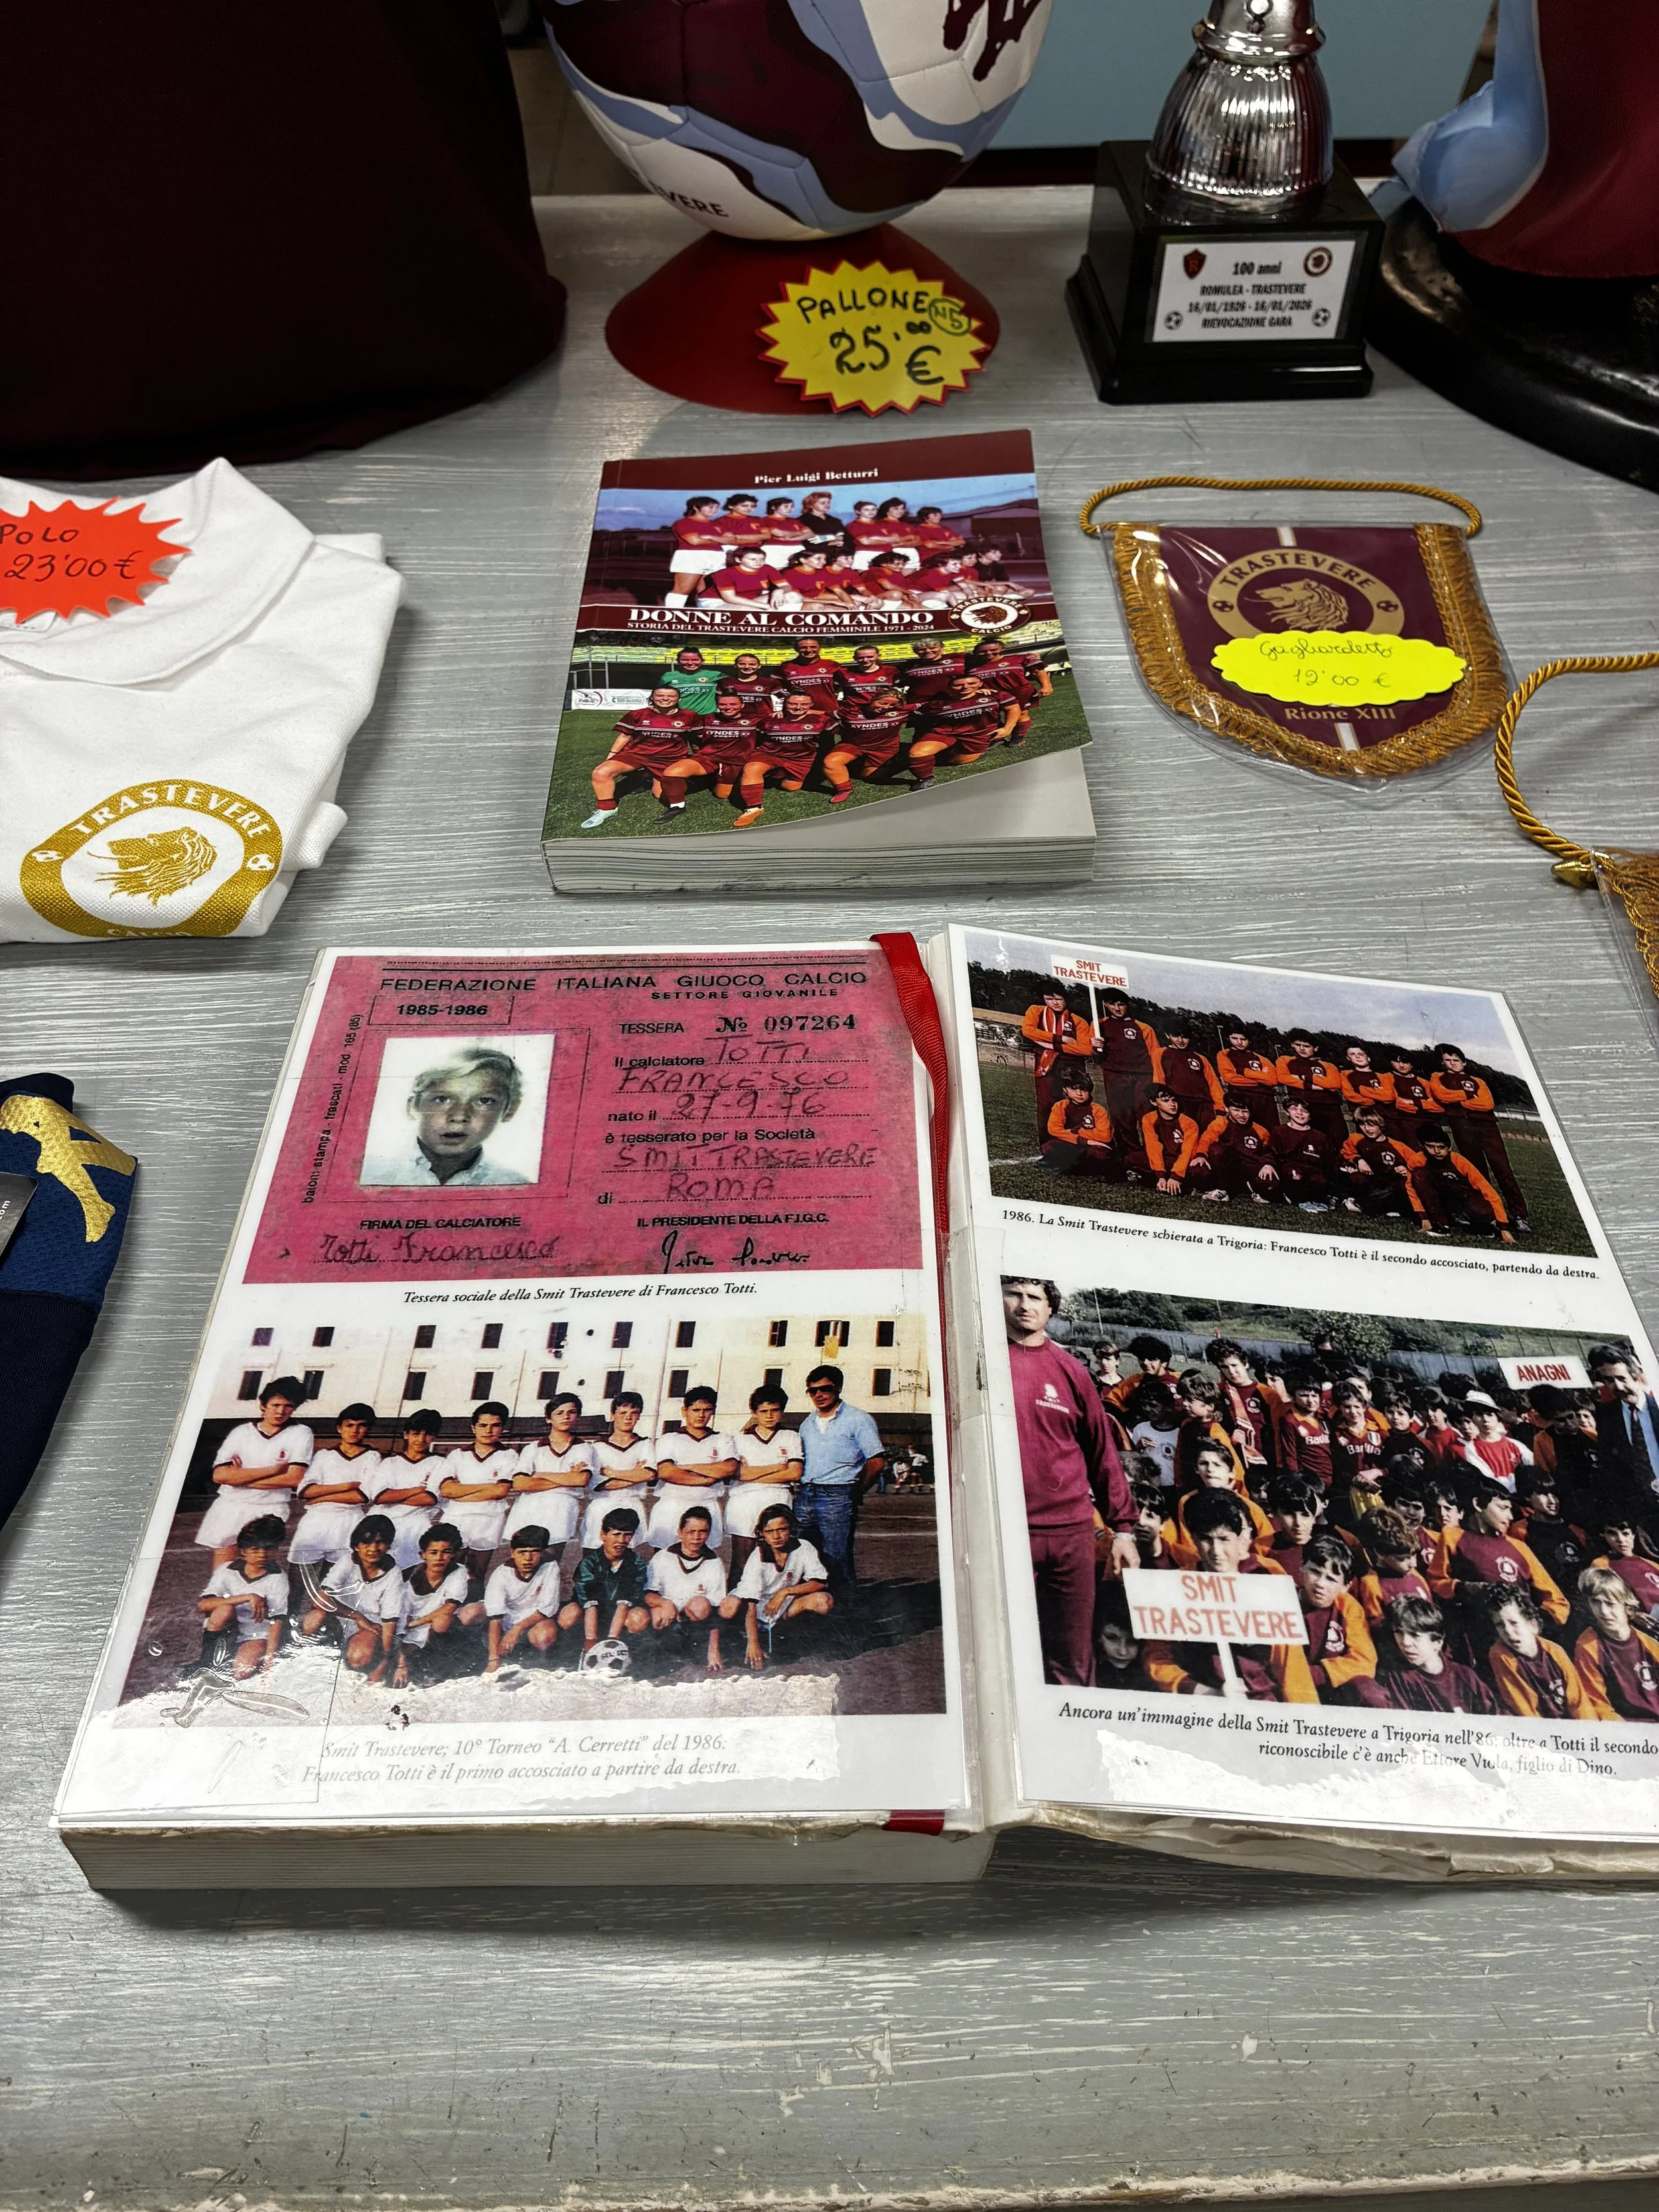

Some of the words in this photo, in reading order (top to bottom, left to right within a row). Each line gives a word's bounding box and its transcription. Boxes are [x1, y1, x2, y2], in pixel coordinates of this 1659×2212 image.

[1232, 262, 1254, 275] 100
[1256, 261, 1282, 275] anni
[1200, 284, 1244, 296] ROMULEA
[1251, 283, 1307, 295] TRASTEVERE
[797, 287, 930, 324] PALLONE
[904, 344, 944, 386] €
[754, 475, 782, 484] Pier
[786, 472, 820, 482] Luigi
[825, 468, 879, 480] Betturri
[114, 550, 144, 579] €
[1219, 552, 1377, 590] TRASTEVERE
[954, 597, 1024, 613] TRASTEVERE
[627, 621, 669, 630] STORIA
[628, 609, 732, 625] DONNE
[738, 613, 778, 626] AL
[785, 612, 934, 627] COMANDO
[971, 624, 1013, 634] CALCIO
[1260, 638, 1394, 661] Gagliardetto
[1285, 707, 1348, 720] Rione
[1354, 707, 1396, 720] XIII
[68, 783, 272, 839] TRASTEVERE
[1076, 960, 1101, 972] SMIT
[380, 978, 537, 992] FEDERAZIONE
[556, 976, 657, 990] ITALIANA
[676, 974, 764, 988] GIUOCO
[784, 972, 867, 986] CALCIO
[1053, 965, 1127, 988] TRASTEVERE
[651, 990, 729, 1000] SETTORE
[742, 988, 839, 999] GIOVANILE
[396, 1004, 488, 1015] 1985-1986
[618, 1023, 684, 1034] TESSERA
[764, 1014, 855, 1032] 097264
[628, 1055, 705, 1067] calciatore
[618, 1067, 849, 1092] FRANCESCO
[608, 1111, 644, 1122] nato
[648, 1110, 657, 1122] il
[605, 1132, 614, 1143] è
[620, 1131, 697, 1143] tesserato
[701, 1130, 727, 1145] per
[735, 1129, 748, 1140] la
[754, 1128, 816, 1140] Società
[313, 1129, 331, 1167] stampa
[598, 1193, 613, 1205] di
[667, 1173, 774, 1202] ROMA
[359, 1219, 402, 1230] FIRMA
[405, 1218, 431, 1230] DEL
[435, 1217, 522, 1228] CALCIATORE
[636, 1217, 649, 1228] IL
[652, 1215, 736, 1228] PRESIDENTE
[738, 1213, 782, 1224] DELLA
[784, 1213, 830, 1223] F.I.G.C.
[1002, 1209, 1035, 1222] 1986.
[1039, 1213, 1054, 1225] La
[1057, 1216, 1086, 1229] Smit
[1088, 1219, 1149, 1237] Trastevere
[1153, 1228, 1203, 1244] schierata
[1206, 1236, 1214, 1245] a
[1217, 1235, 1267, 1250] Trigoria:
[1270, 1240, 1327, 1257] Francesco
[1329, 1246, 1358, 1259] Totti
[1361, 1250, 1368, 1260] è
[1371, 1250, 1379, 1261] il
[1382, 1253, 1427, 1266] secondo
[1430, 1258, 1489, 1272] accosciato,
[1492, 1262, 1543, 1275] partendo
[1546, 1264, 1559, 1276] da
[1562, 1266, 1599, 1280] destra.
[403, 1291, 449, 1303] Tessera
[452, 1289, 497, 1302] sociale
[499, 1288, 532, 1301] della
[534, 1288, 565, 1300] Smit
[569, 1286, 636, 1299] Trastevere
[638, 1284, 653, 1296] di
[655, 1284, 719, 1296] Francesco
[723, 1282, 757, 1294] Totti.
[1516, 1363, 1571, 1383] ANAGNI
[1180, 1574, 1238, 1602] SMIT
[1133, 1605, 1304, 1639] TRASTEVERE
[1058, 1702, 1112, 1720] Ancora
[1218, 1713, 1252, 1731] della
[1256, 1716, 1289, 1734] Smit
[1293, 1718, 1367, 1739] Trastevere
[1371, 1729, 1378, 1739] a
[1382, 1725, 1440, 1745] Trigoria
[1502, 1732, 1535, 1748] oltre
[1539, 1739, 1548, 1748] a
[1550, 1734, 1585, 1751] Totti
[1590, 1736, 1600, 1752] il
[1604, 1739, 1658, 1754] secondo
[321, 1741, 359, 1758] Smit
[364, 1740, 449, 1758] Trastevere;
[488, 1737, 541, 1755] Torneo
[652, 1733, 679, 1751] del
[683, 1733, 727, 1751] 1986:
[1258, 1741, 1348, 1760] riconoscibile
[1376, 1748, 1417, 1765] anche
[1517, 1754, 1554, 1775] figlio
[1559, 1757, 1572, 1773] di
[1576, 1757, 1617, 1775] Dino.
[301, 1765, 380, 1783] Francesco
[386, 1763, 425, 1781] Totti
[427, 1765, 437, 1780] è
[440, 1762, 455, 1780] il
[455, 1765, 504, 1784] primo
[507, 1762, 587, 1779] accosciato
[591, 1766, 601, 1777] a
[605, 1759, 660, 1781] partire
[664, 1757, 683, 1775] da
[688, 1757, 740, 1775] destra.
